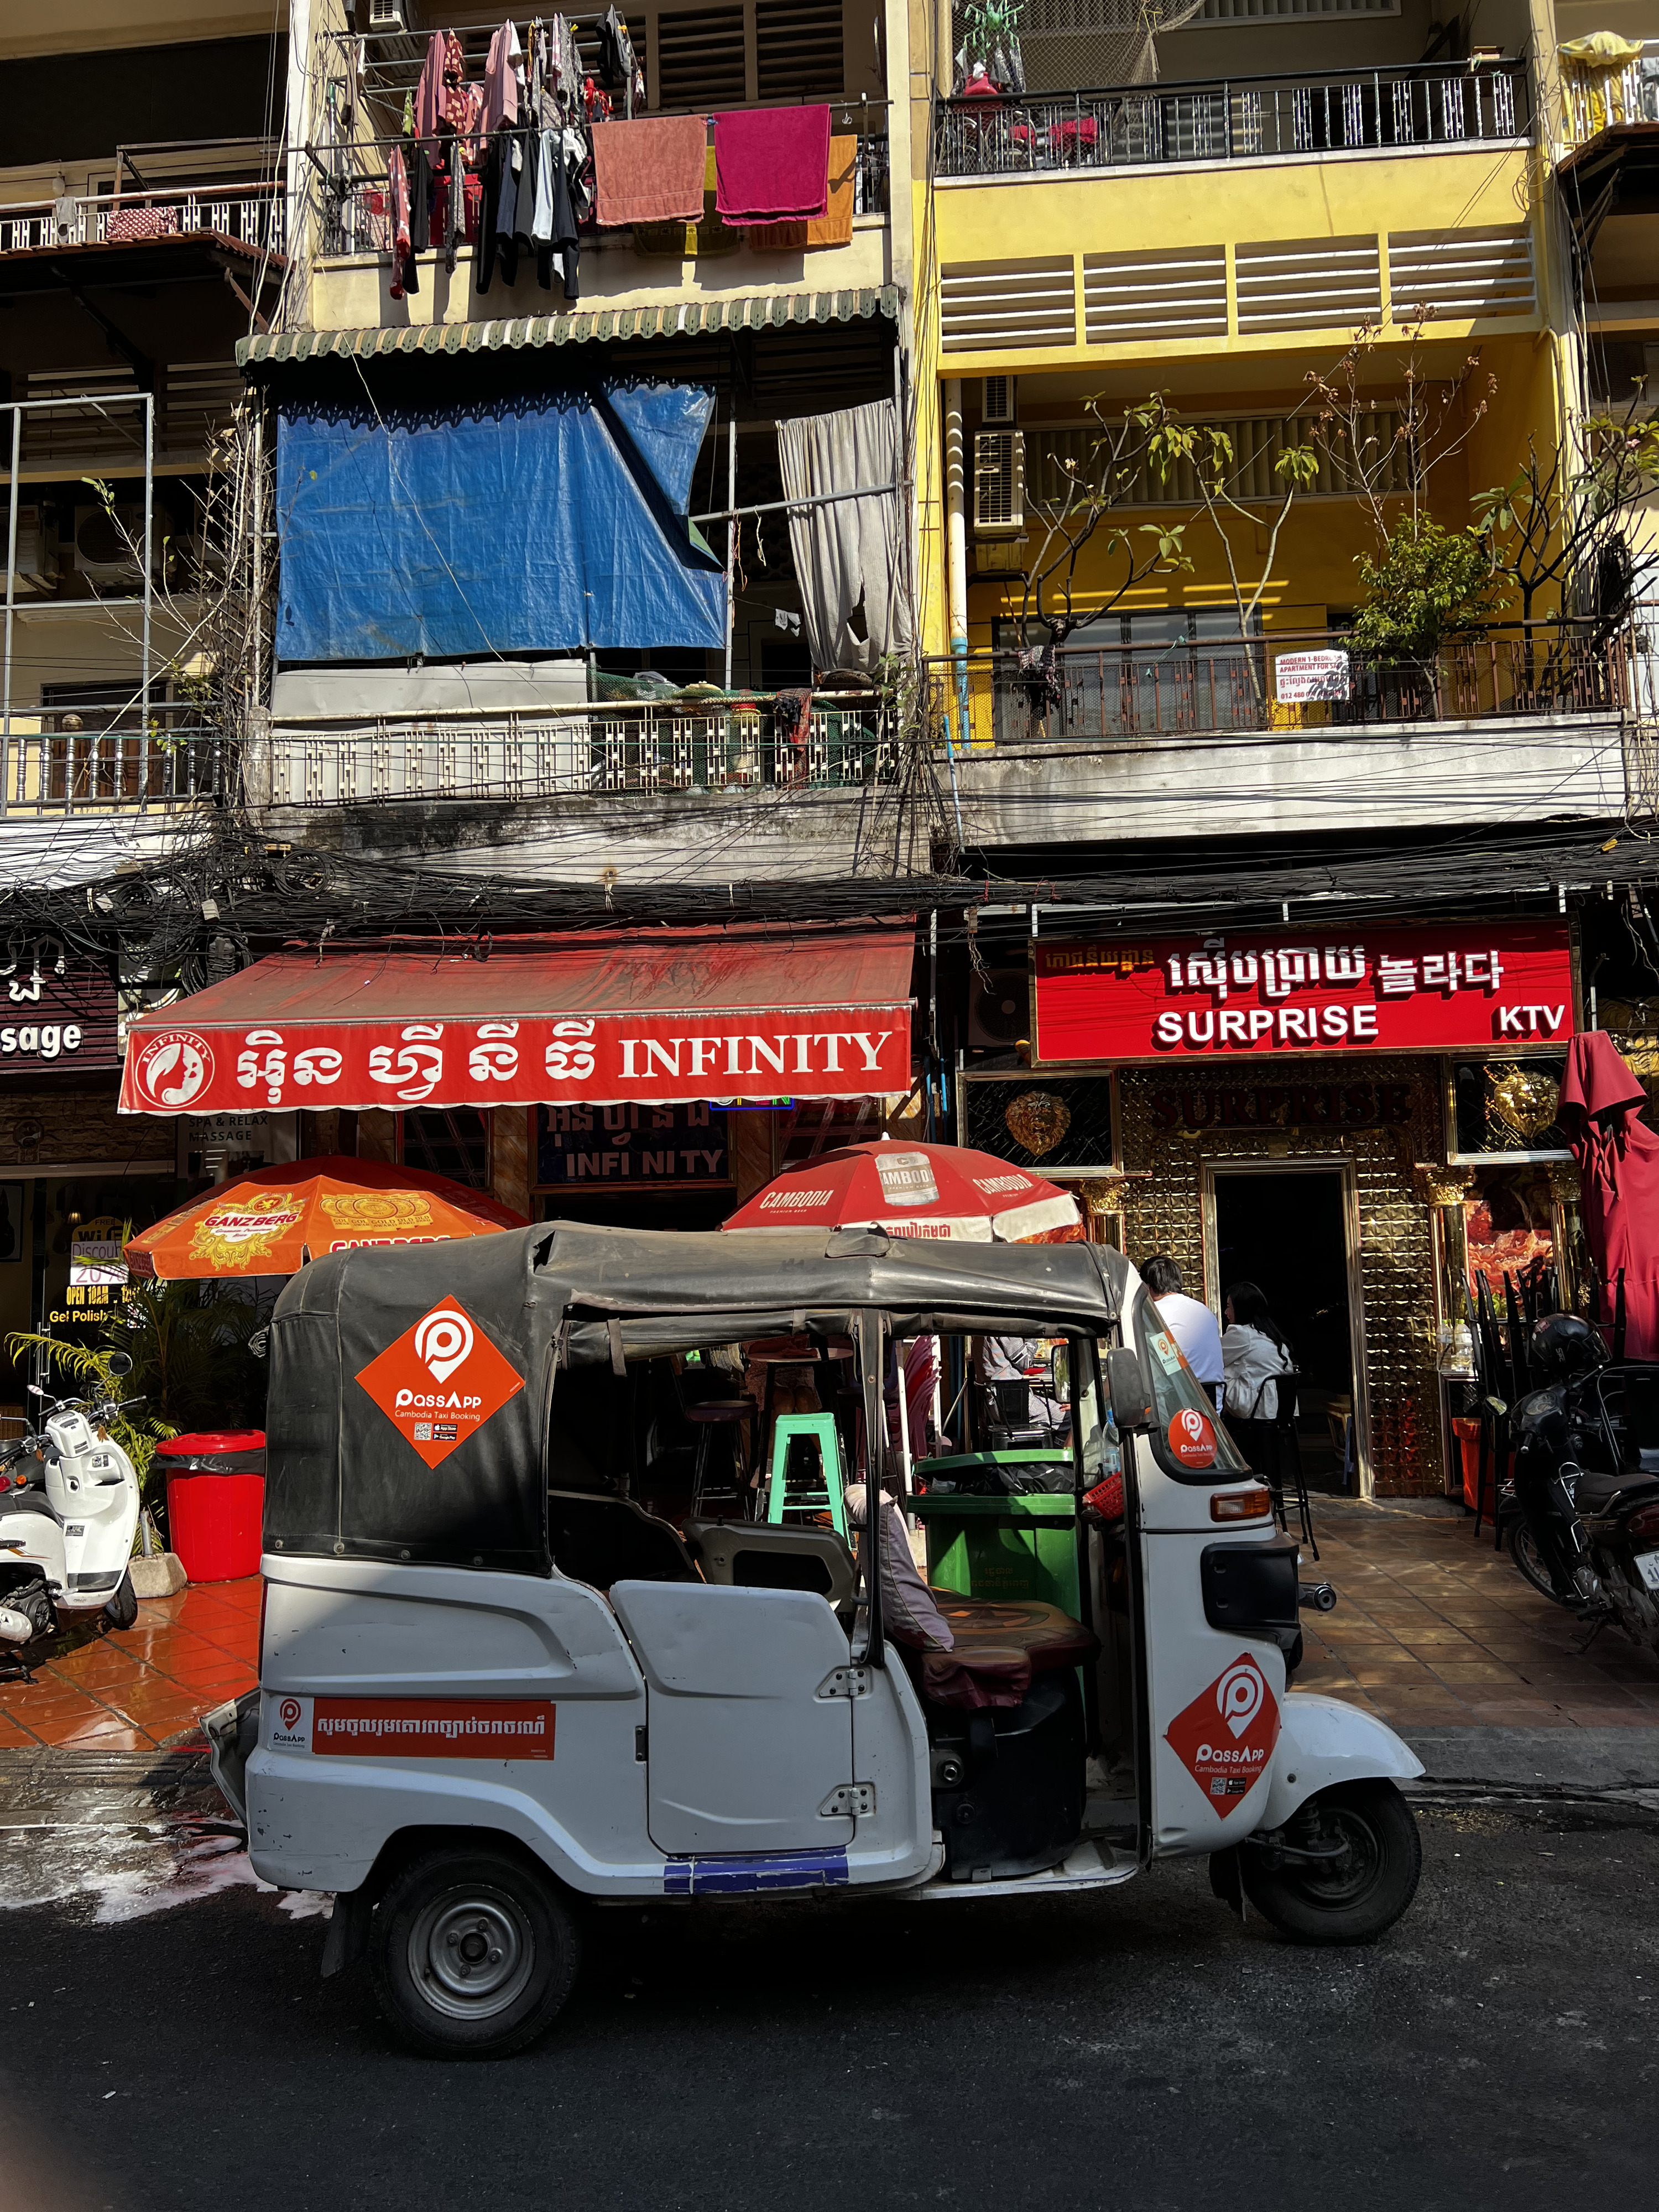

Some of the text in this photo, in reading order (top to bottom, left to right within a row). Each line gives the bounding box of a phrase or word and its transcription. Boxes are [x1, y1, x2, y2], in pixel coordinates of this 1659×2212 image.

[1280, 664, 1315, 673] APARTMENT
[1377, 949, 1505, 994] 놀라다
[1157, 1005, 1379, 1042] SURPRISE
[1500, 1004, 1565, 1031] KTV
[142, 1034, 211, 1063] INFINITY
[468, 1021, 519, 1082] នី
[618, 1031, 893, 1078] INFINITY
[1152, 1083, 1413, 1128] SURPRISE
[189, 1115, 268, 1127] SPA & RELAX
[189, 1130, 252, 1141] MASSAGE
[973, 1174, 1034, 1194] CAMBODIA
[759, 1190, 834, 1209] CAMBODIA
[205, 1212, 299, 1227] GANZBERG
[72, 1244, 123, 1259] Discoun
[66, 1286, 85, 1305] OPEN
[87, 1285, 109, 1305] 10AM
[50, 1311, 69, 1323] Gel
[395, 1389, 482, 1408] PassApp
[395, 1410, 481, 1421] Cambodia Taxi Booking
[1181, 1443, 1213, 1453] PassApp
[274, 1733, 305, 1742] PassApp
[1196, 1744, 1264, 1763] PassApp
[1194, 1765, 1262, 1774] Cambodia Taxi Booking
